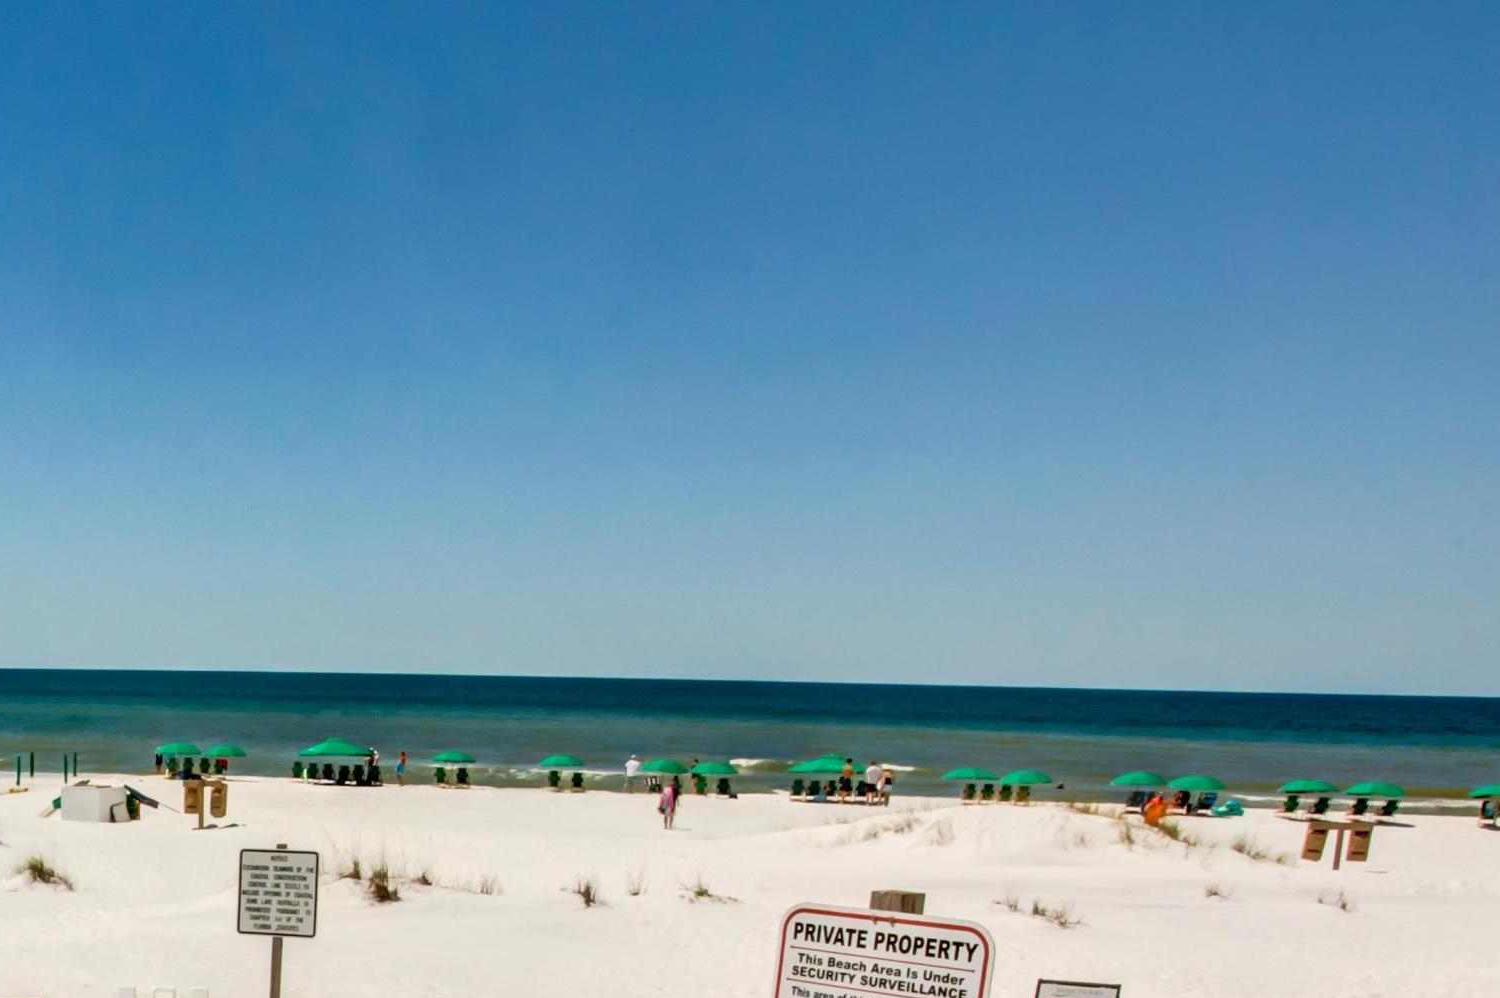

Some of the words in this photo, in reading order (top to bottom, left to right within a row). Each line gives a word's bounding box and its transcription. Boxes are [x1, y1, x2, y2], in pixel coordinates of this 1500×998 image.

[793, 922, 867, 949] PRIVATE
[874, 932, 979, 963] PROPERTY
[792, 965, 856, 984] SECURITY
[798, 953, 823, 965] This
[828, 958, 867, 972] Beach
[871, 964, 901, 977] Area
[906, 968, 917, 979] Is
[923, 970, 965, 986] Under
[791, 986, 811, 998] This
